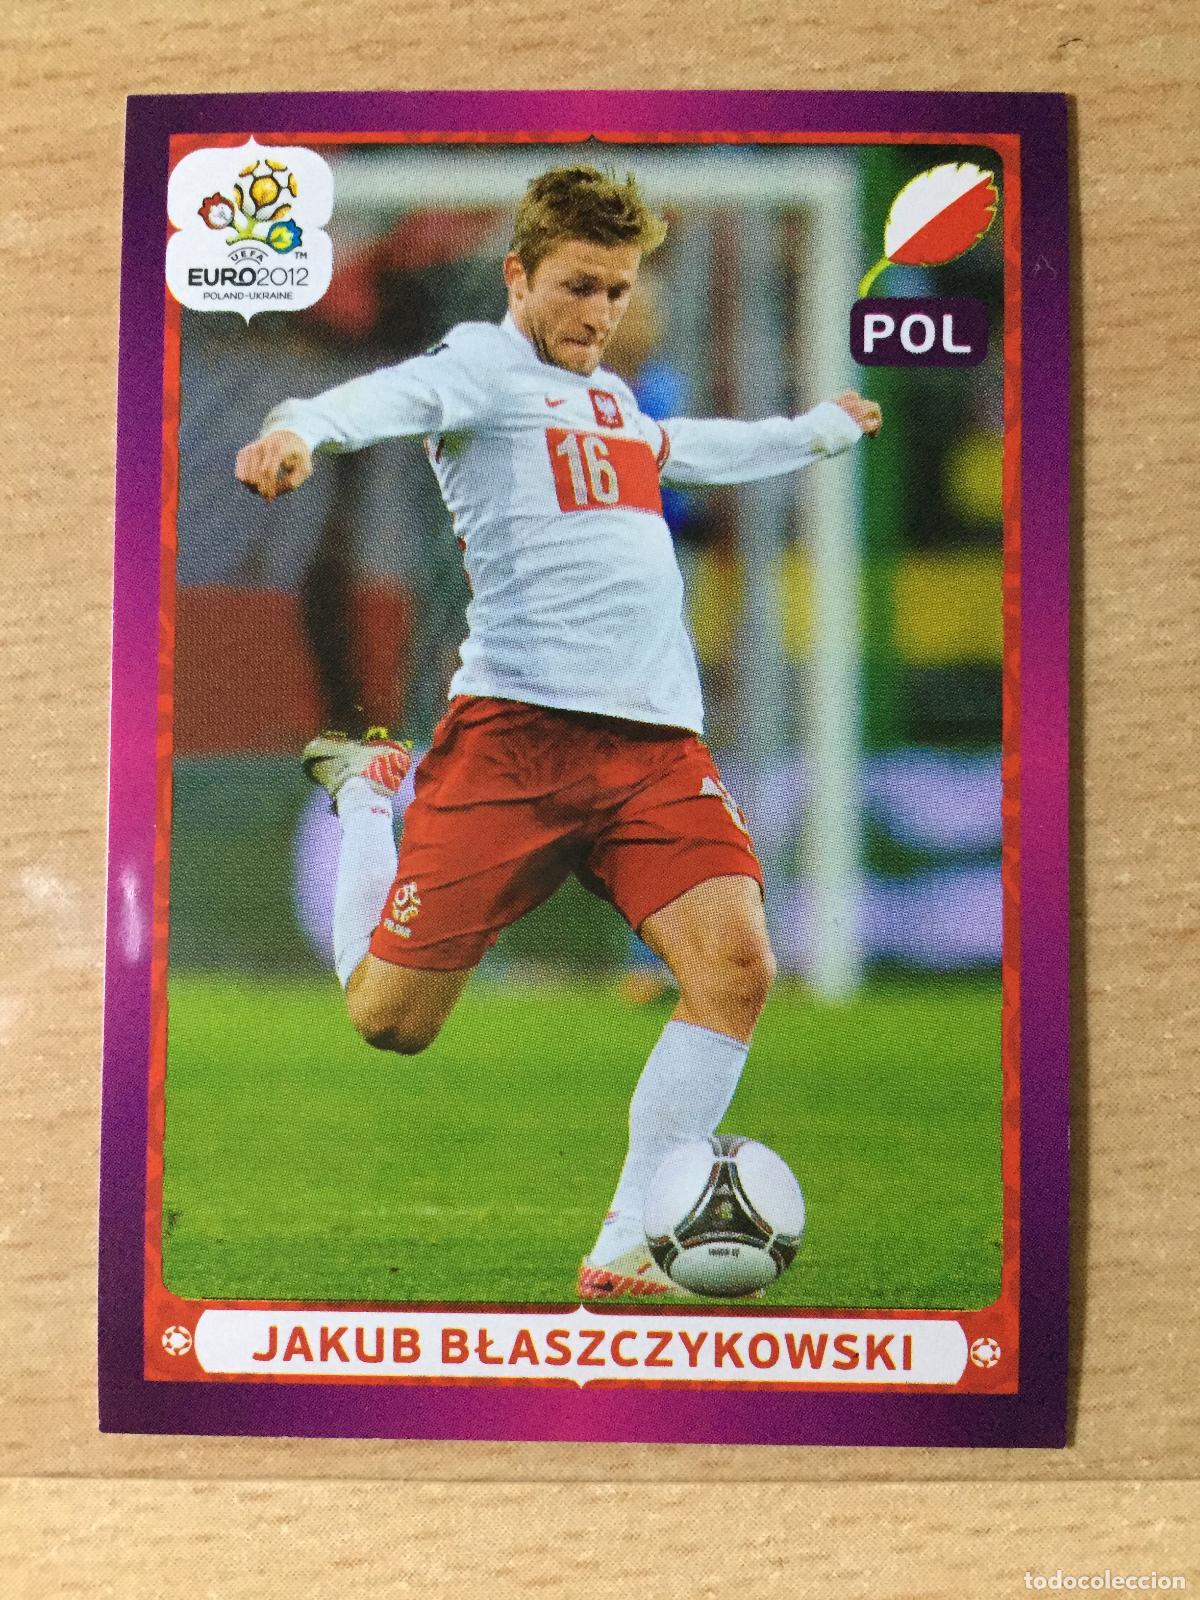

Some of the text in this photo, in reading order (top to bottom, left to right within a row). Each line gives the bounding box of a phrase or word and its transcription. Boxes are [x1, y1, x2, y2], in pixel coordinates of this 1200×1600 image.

[230, 250, 265, 263] UEFA
[203, 291, 294, 301] POLAND-UKRAINE
[863, 313, 972, 354] POL
[556, 432, 620, 505] 16
[252, 1325, 913, 1371] JAKUB BŁASZCZYKOWSKI
